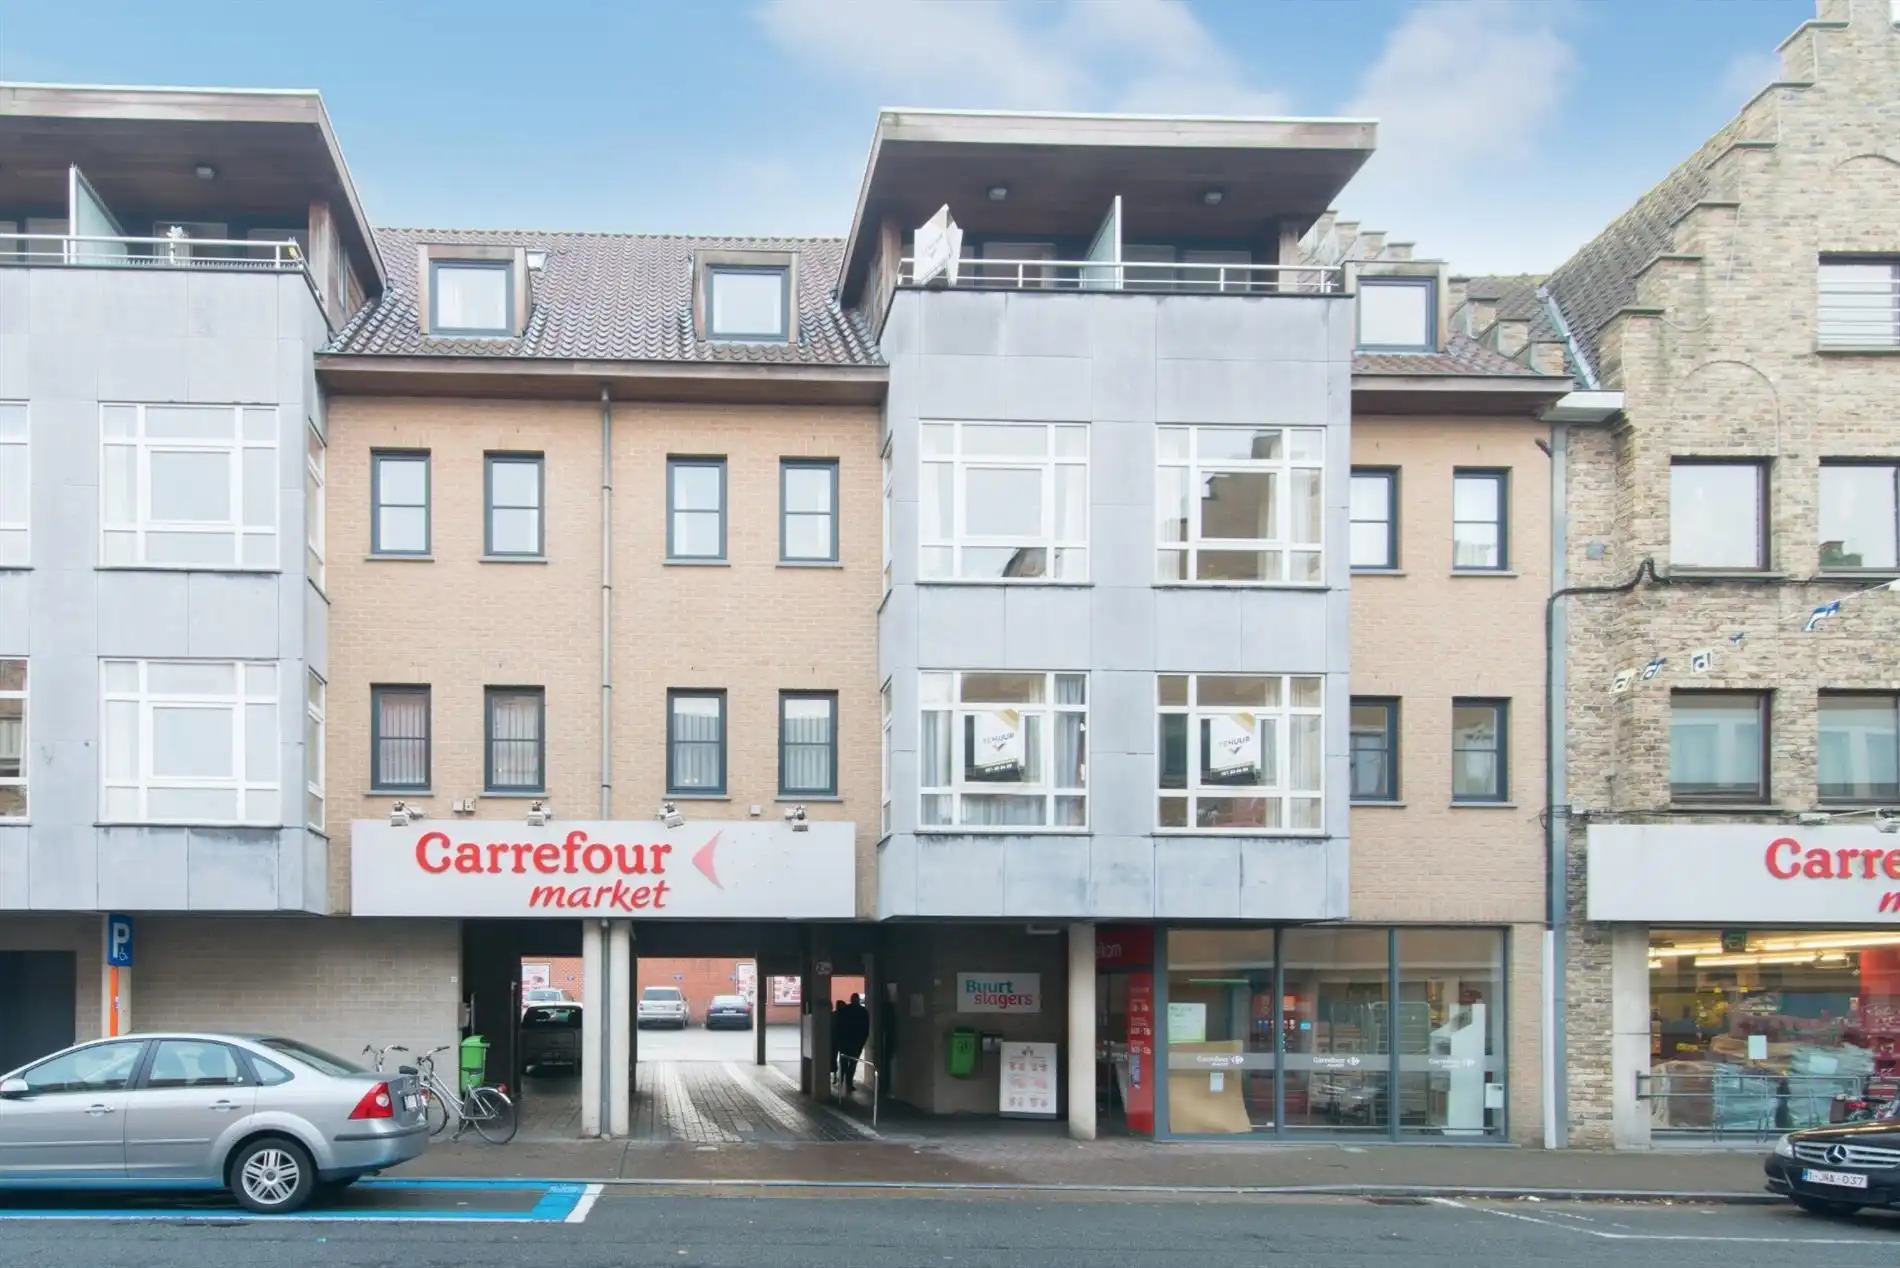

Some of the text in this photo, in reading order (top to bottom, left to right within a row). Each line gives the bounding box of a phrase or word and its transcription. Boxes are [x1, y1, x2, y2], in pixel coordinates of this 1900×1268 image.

[415, 830, 673, 875] Carrefour
[1764, 837, 1900, 879] Carre
[529, 878, 671, 912] market
[113, 922, 130, 958] P
[965, 979, 1014, 994] Buurt
[974, 991, 1033, 1009] slagers
